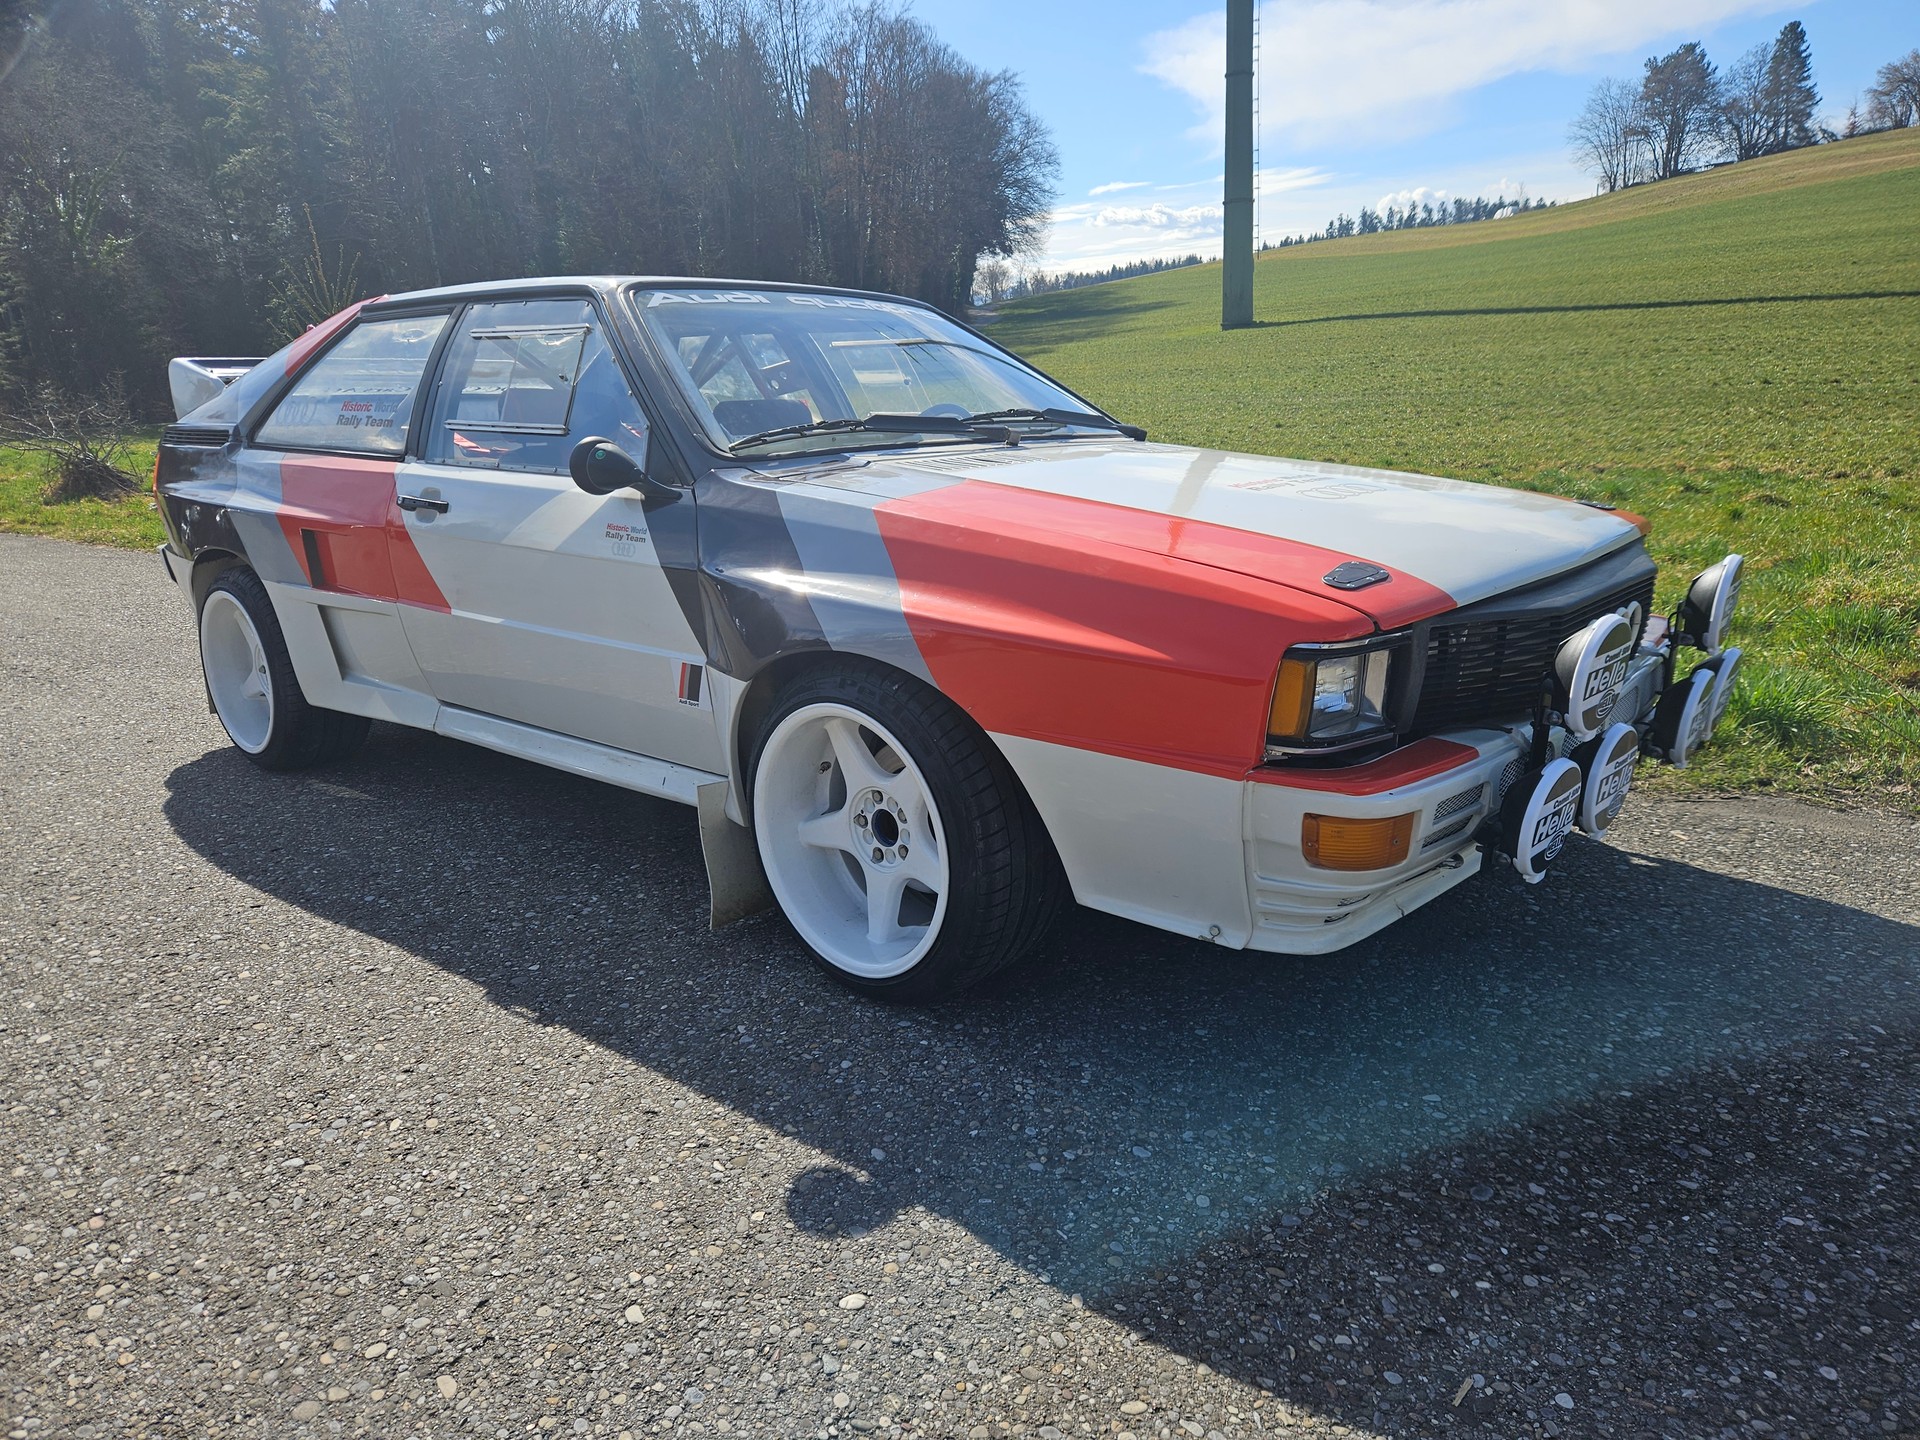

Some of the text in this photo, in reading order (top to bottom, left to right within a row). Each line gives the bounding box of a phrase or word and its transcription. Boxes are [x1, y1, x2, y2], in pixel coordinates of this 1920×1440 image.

[341, 401, 373, 412] Historic
[336, 414, 393, 429] Rally Team
[606, 523, 647, 535] Historic World
[605, 531, 646, 543] Rally Team
[1585, 661, 1626, 699] Hella
[1597, 765, 1633, 804] Hella
[1534, 802, 1576, 846] Hella
